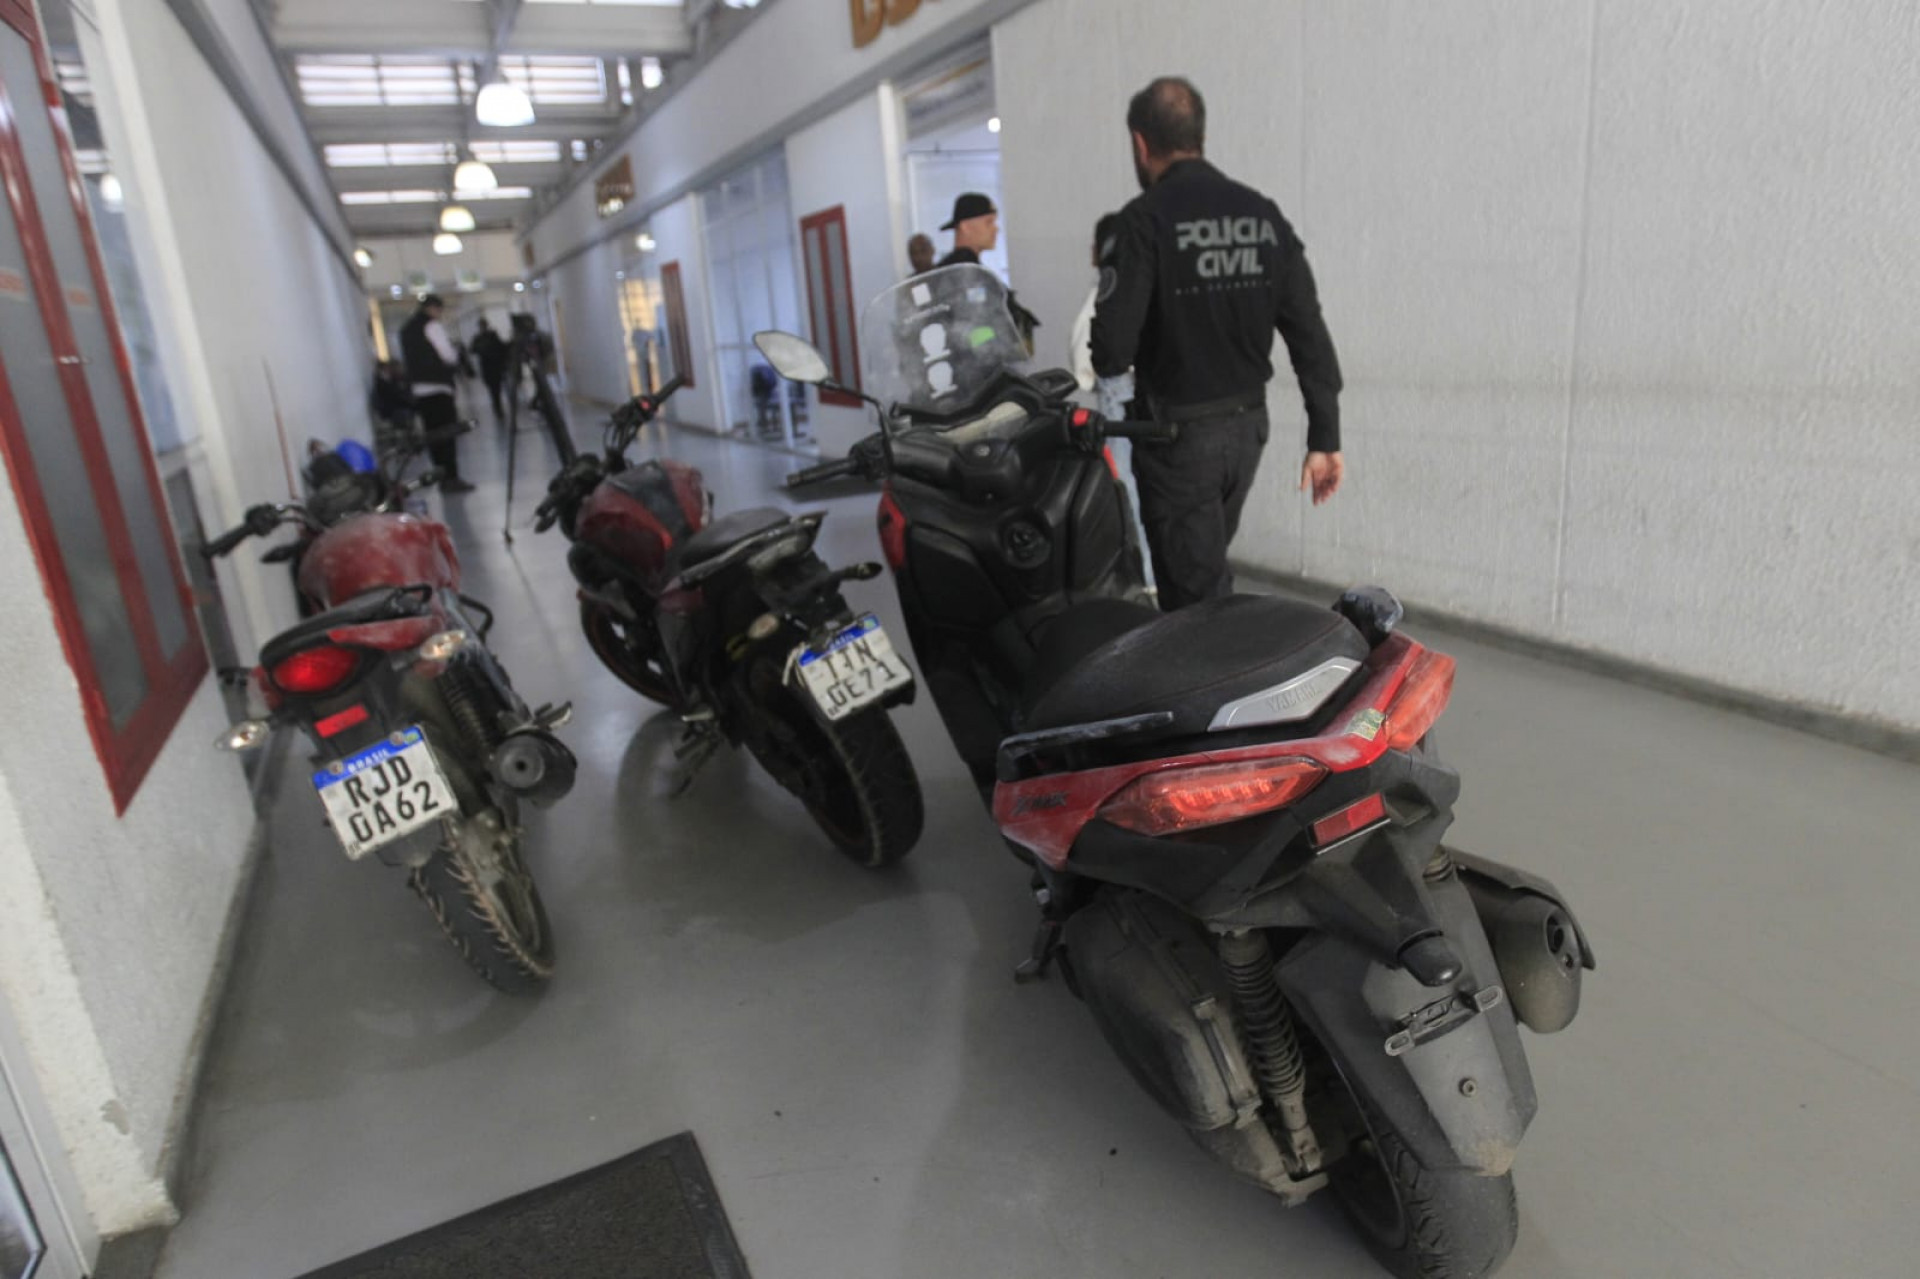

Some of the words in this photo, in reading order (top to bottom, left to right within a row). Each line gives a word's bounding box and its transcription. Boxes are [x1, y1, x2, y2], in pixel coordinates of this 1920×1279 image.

[1197, 248, 1263, 277] CIVIL
[347, 748, 390, 773] BRASIL
[344, 756, 412, 808] RJD
